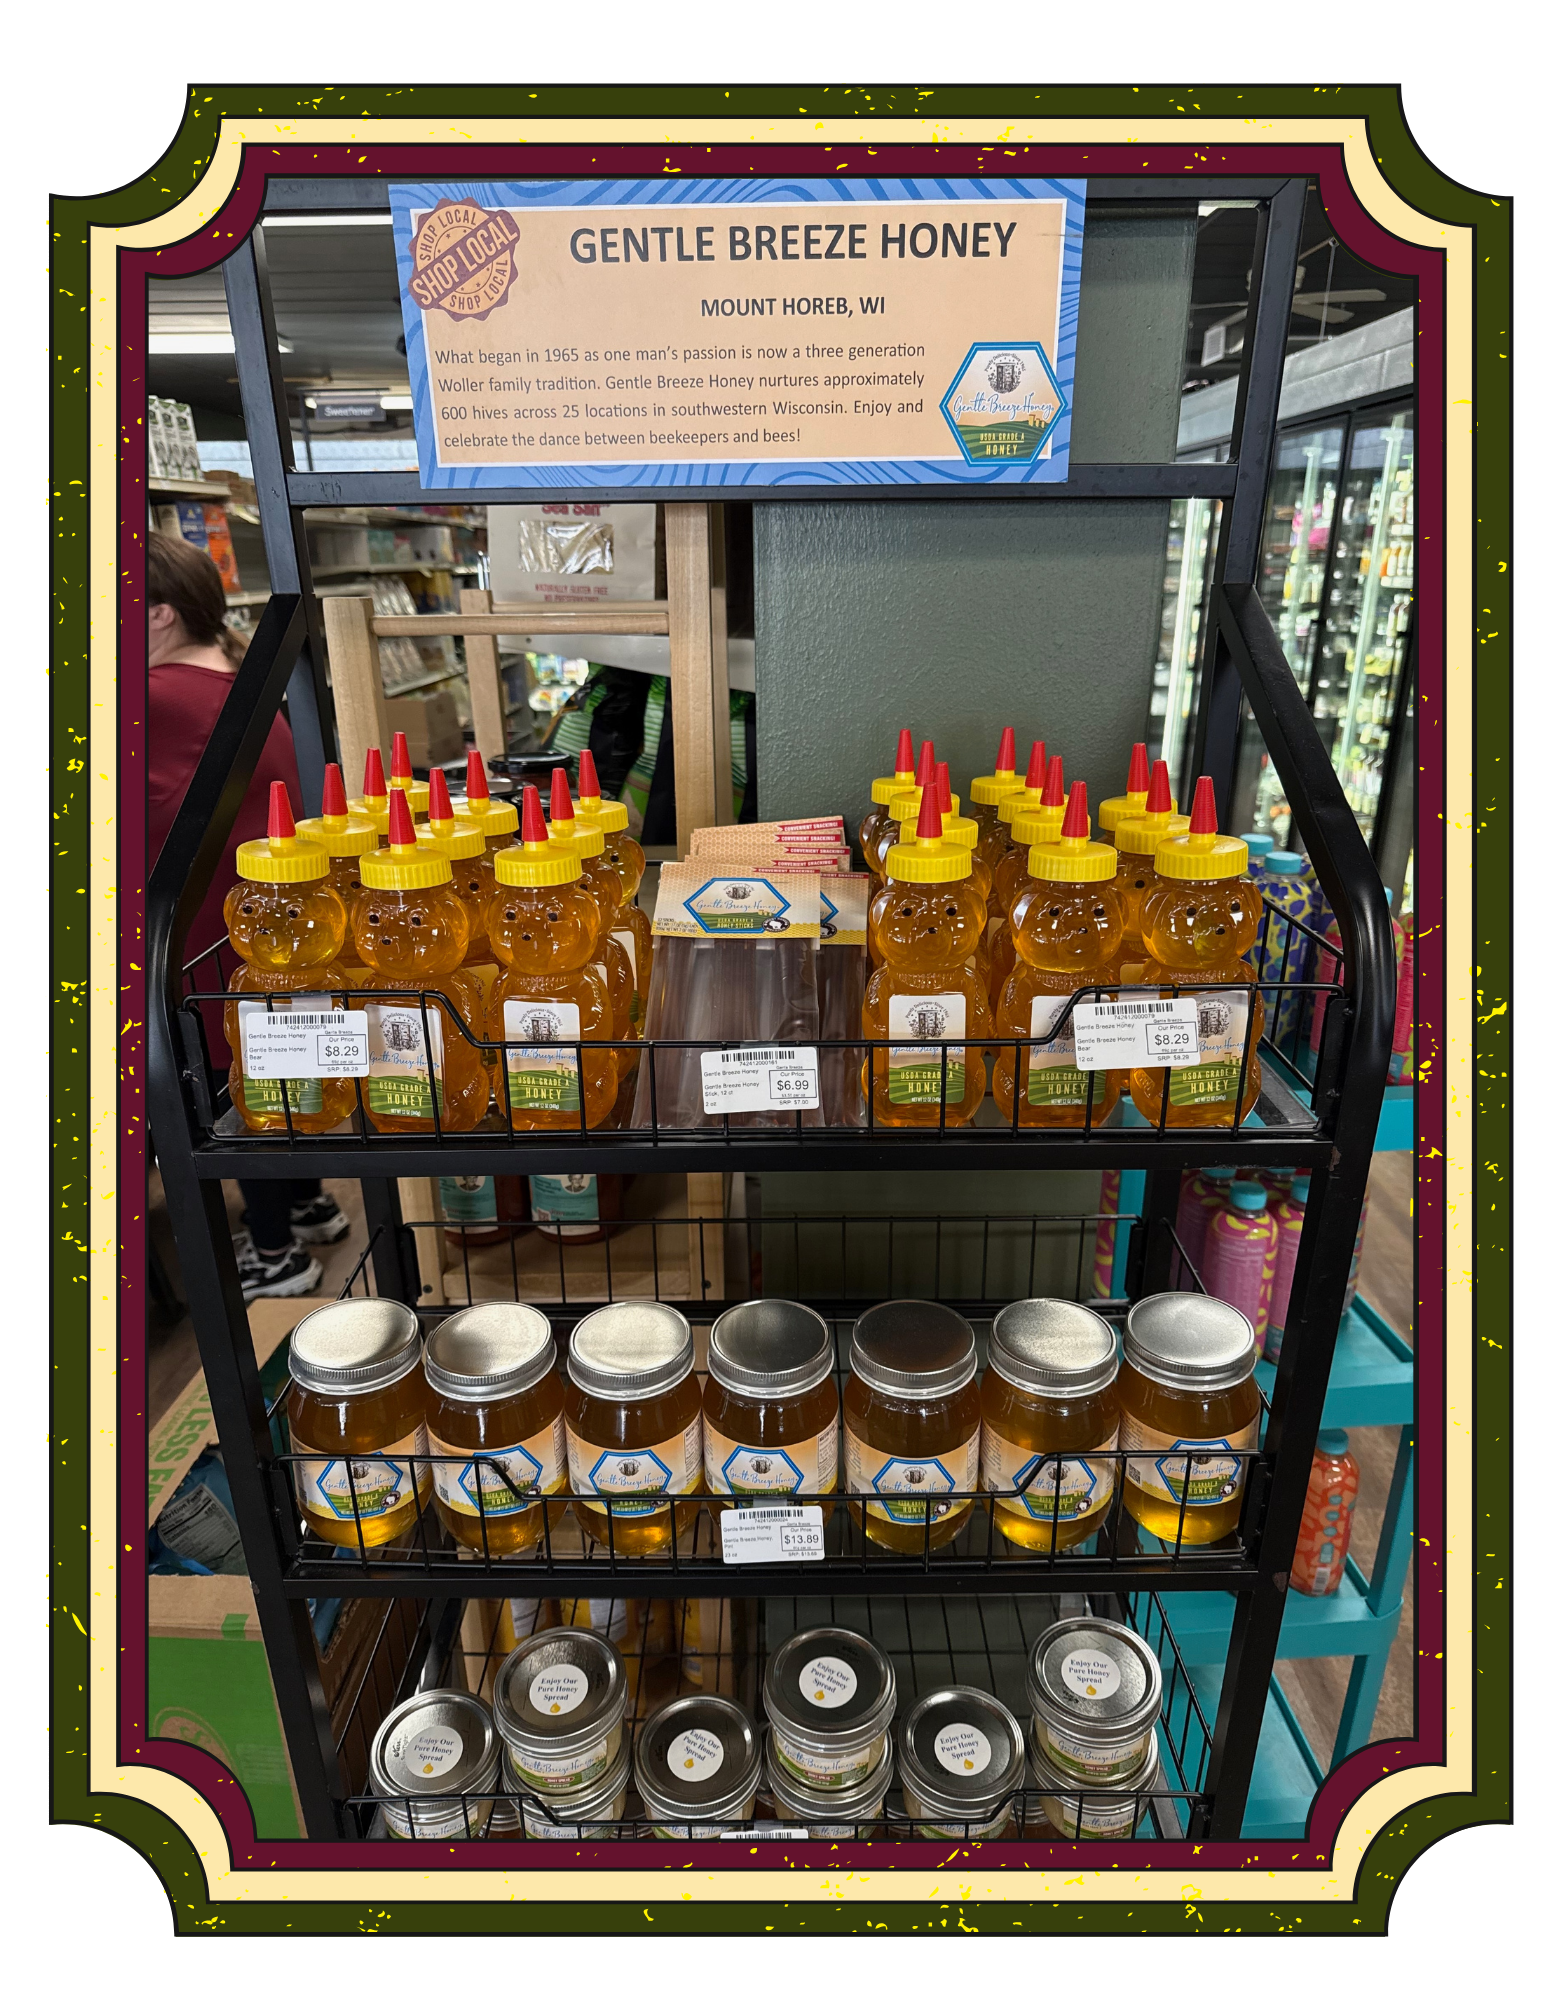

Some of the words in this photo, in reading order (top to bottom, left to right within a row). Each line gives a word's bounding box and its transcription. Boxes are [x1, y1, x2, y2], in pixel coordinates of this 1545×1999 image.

[420, 225, 438, 261] SHOP
[438, 209, 476, 229] LOCAL
[570, 227, 715, 264] GENTLE
[729, 224, 867, 261] BREEZE
[880, 222, 1017, 258] HONEY
[412, 254, 459, 305] SHOP
[456, 216, 518, 272] LOCAL
[450, 294, 481, 310] SHOP
[484, 260, 508, 301] LOCAL
[701, 298, 777, 317] MOUNT
[782, 297, 853, 318] HOREB,
[859, 296, 885, 315] WI
[435, 350, 473, 364] What
[479, 349, 521, 367] began
[526, 349, 539, 363] in
[544, 348, 579, 362] 1965
[584, 350, 599, 362] as
[604, 349, 631, 361] one
[683, 345, 736, 363] passion
[741, 345, 752, 359] is
[757, 347, 788, 359] now
[792, 346, 800, 358] a
[805, 344, 844, 358] three
[848, 343, 925, 361] generation
[438, 378, 484, 392] Woller
[489, 377, 531, 394] family
[536, 376, 601, 390] tradition.
[606, 375, 652, 390] Gentle
[657, 375, 704, 389] Breeze
[709, 374, 754, 391] Honey
[759, 373, 819, 387] nurtures
[824, 371, 925, 389] approximately
[441, 406, 467, 420] 600
[472, 405, 508, 419] hives
[514, 407, 557, 419] across
[562, 404, 580, 419] 25
[585, 403, 647, 418] locations
[653, 403, 666, 417] in
[671, 402, 767, 417] southwestern
[772, 400, 848, 415] Wisconsin.
[854, 400, 892, 417] Enjoy
[897, 398, 924, 413] and
[953, 392, 987, 421] Gentle
[987, 393, 1023, 420] Breeze
[444, 433, 508, 448] celebrate
[512, 432, 535, 447] the
[539, 432, 580, 447] dance
[585, 431, 645, 446] between
[649, 429, 729, 447] beekeepers
[733, 428, 759, 443] and
[763, 428, 801, 443] bees!
[980, 433, 996, 441] USDA
[998, 433, 1018, 441] GRADE
[1020, 432, 1025, 441] A
[986, 444, 1018, 455] HONEY
[784, 823, 812, 831] CONVENIENT
[813, 822, 838, 830] SNACKING!
[1154, 1033, 1189, 1046] $8.29
[1199, 1040, 1222, 1055] Breeze
[1224, 1037, 1245, 1051] Honey
[325, 1045, 359, 1057] $8.29
[1041, 1073, 1060, 1081] USDA
[1063, 1072, 1087, 1080] GRADE
[1182, 1072, 1202, 1081] USDA
[1205, 1069, 1229, 1079] GRADE
[1232, 1068, 1237, 1076] A
[518, 1076, 536, 1085] USDA
[540, 1077, 562, 1087] GRADE
[565, 1079, 570, 1087] A
[777, 1079, 809, 1091] $6.99
[1190, 1080, 1229, 1094] HONEY
[525, 1087, 562, 1100] HONEY
[1048, 1083, 1087, 1095] HONEY
[387, 1093, 423, 1107] HONEY
[154, 1407, 212, 1463] LESS
[596, 1473, 618, 1486] Gentle
[618, 1476, 642, 1490] Breeze
[784, 1534, 819, 1545] $13.89
[1070, 1659, 1091, 1668] Enjoy
[1093, 1661, 1109, 1669] Our
[817, 1661, 835, 1675] Enjoy
[836, 1671, 851, 1682] Our
[1068, 1667, 1086, 1675] Pure
[1087, 1668, 1110, 1678] Honey
[810, 1667, 826, 1679] Pure
[826, 1675, 848, 1691] Honey
[813, 1677, 837, 1694] Spread
[1076, 1675, 1102, 1684] Spread
[555, 1686, 579, 1694] Honey
[543, 1694, 569, 1702] Spread
[419, 1737, 439, 1745] Enjoy
[690, 1729, 706, 1743] Enjoy
[707, 1739, 721, 1750] Our
[940, 1736, 959, 1745] Enjoy
[431, 1746, 454, 1756] Honey
[683, 1735, 698, 1747] Pure
[697, 1743, 718, 1759] Honey
[941, 1745, 957, 1753] Pure
[958, 1740, 979, 1749] Honey
[418, 1753, 443, 1762] Spread
[684, 1746, 706, 1762] Spread
[951, 1748, 976, 1760] Spread
